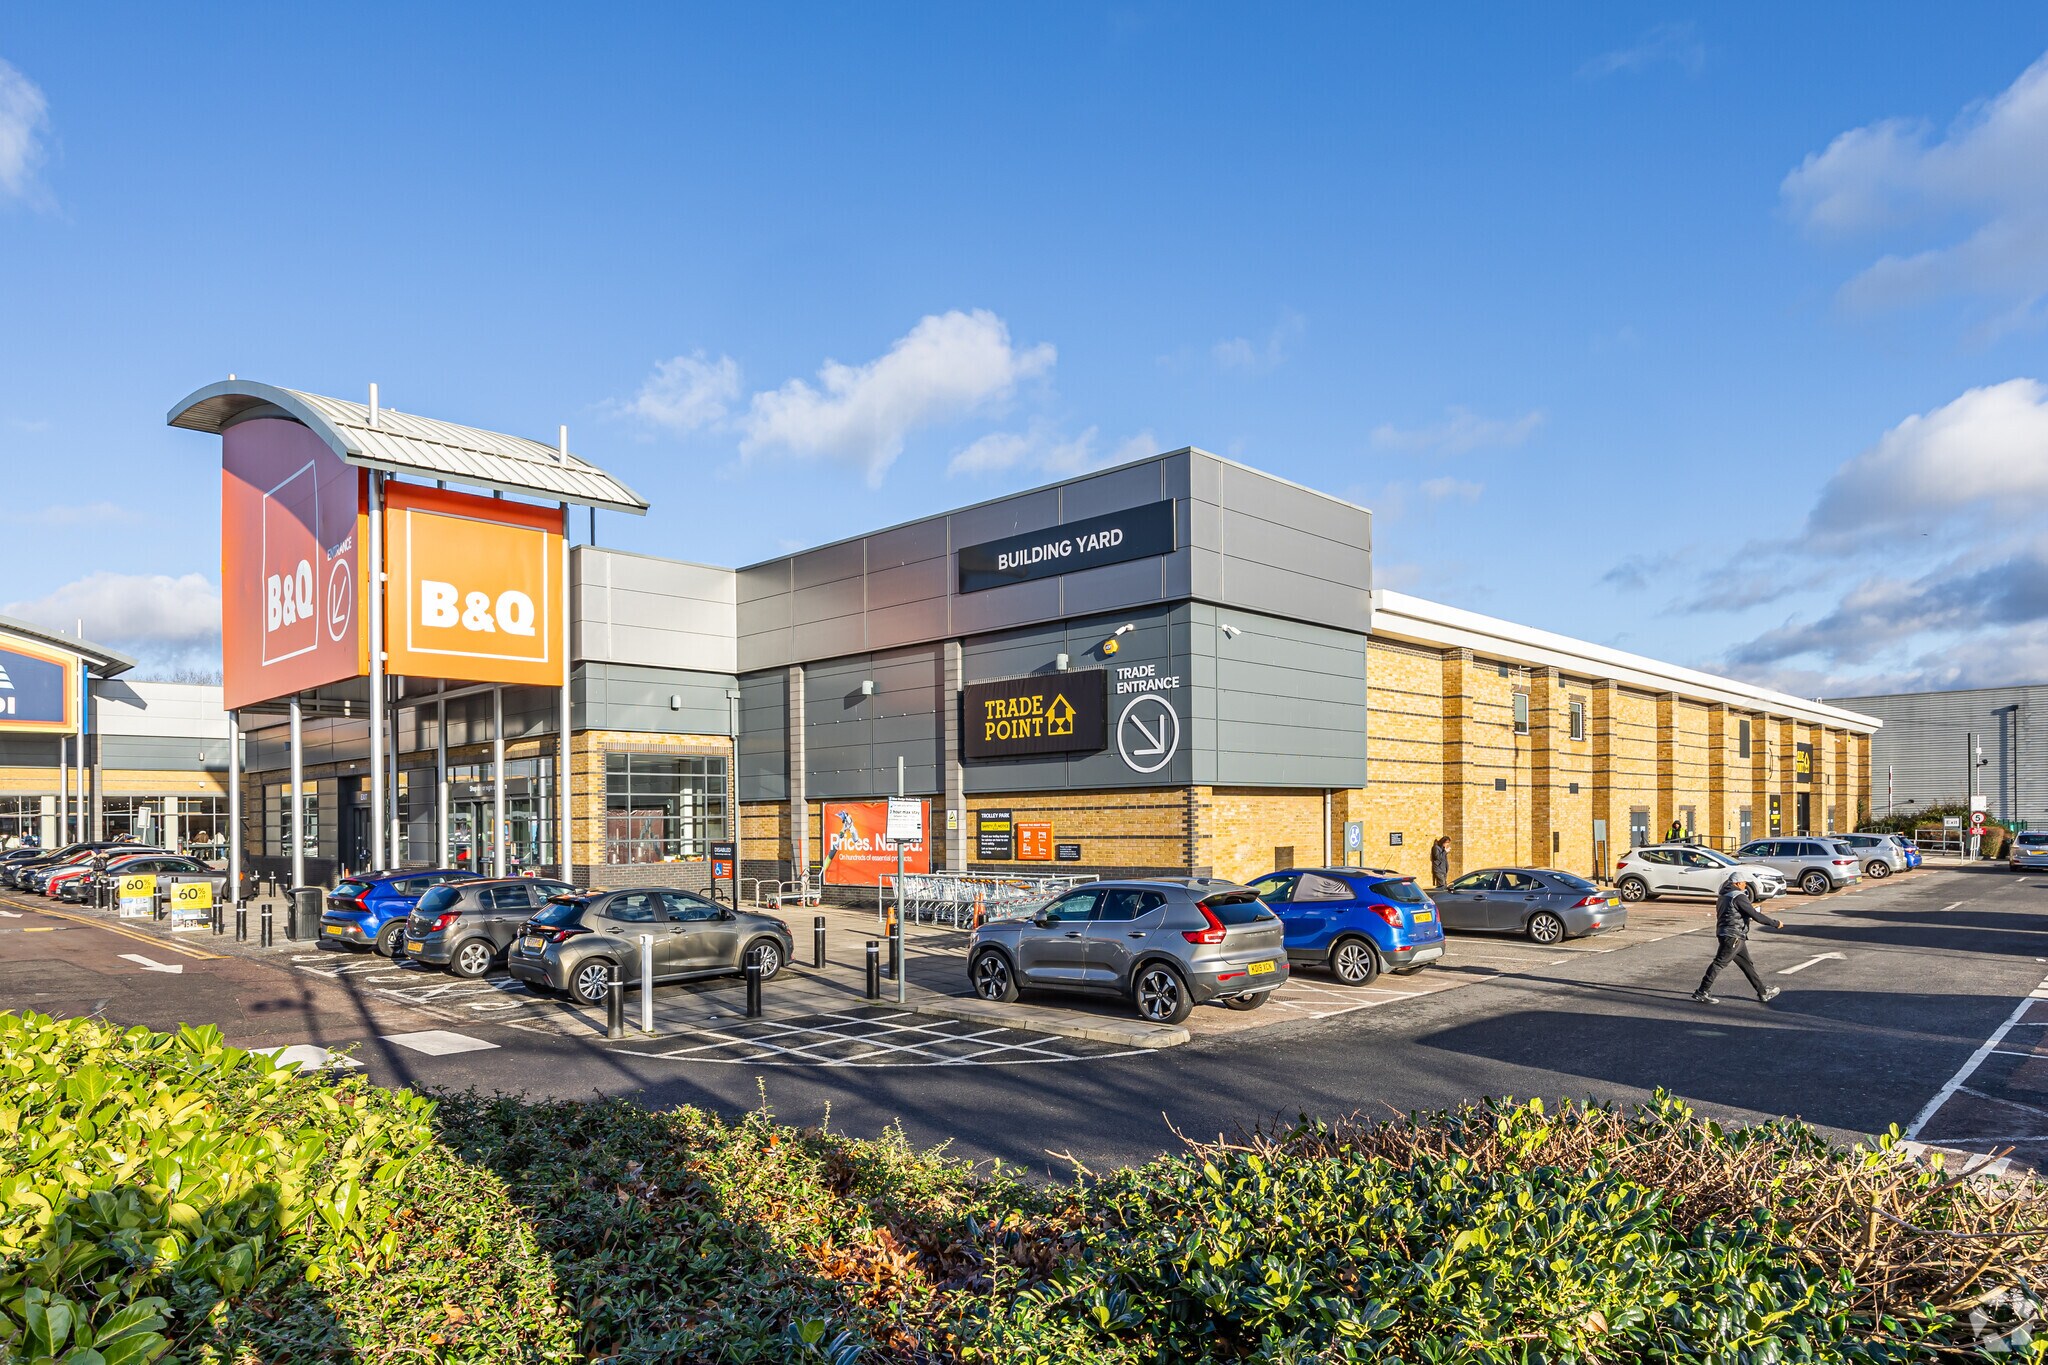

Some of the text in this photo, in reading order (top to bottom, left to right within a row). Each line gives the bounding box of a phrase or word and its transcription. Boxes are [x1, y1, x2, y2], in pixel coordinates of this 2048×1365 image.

[328, 536, 352, 561] ENTRANCE
[998, 528, 1123, 570] BUILDING YARD
[267, 559, 313, 633] B&Q
[421, 579, 536, 636] B&Q
[1117, 664, 1155, 680] TRADE
[1116, 676, 1180, 694] ENTRANCE
[985, 695, 1043, 719] TRADE
[985, 717, 1043, 741] POINT
[830, 833, 873, 851] Prices.
